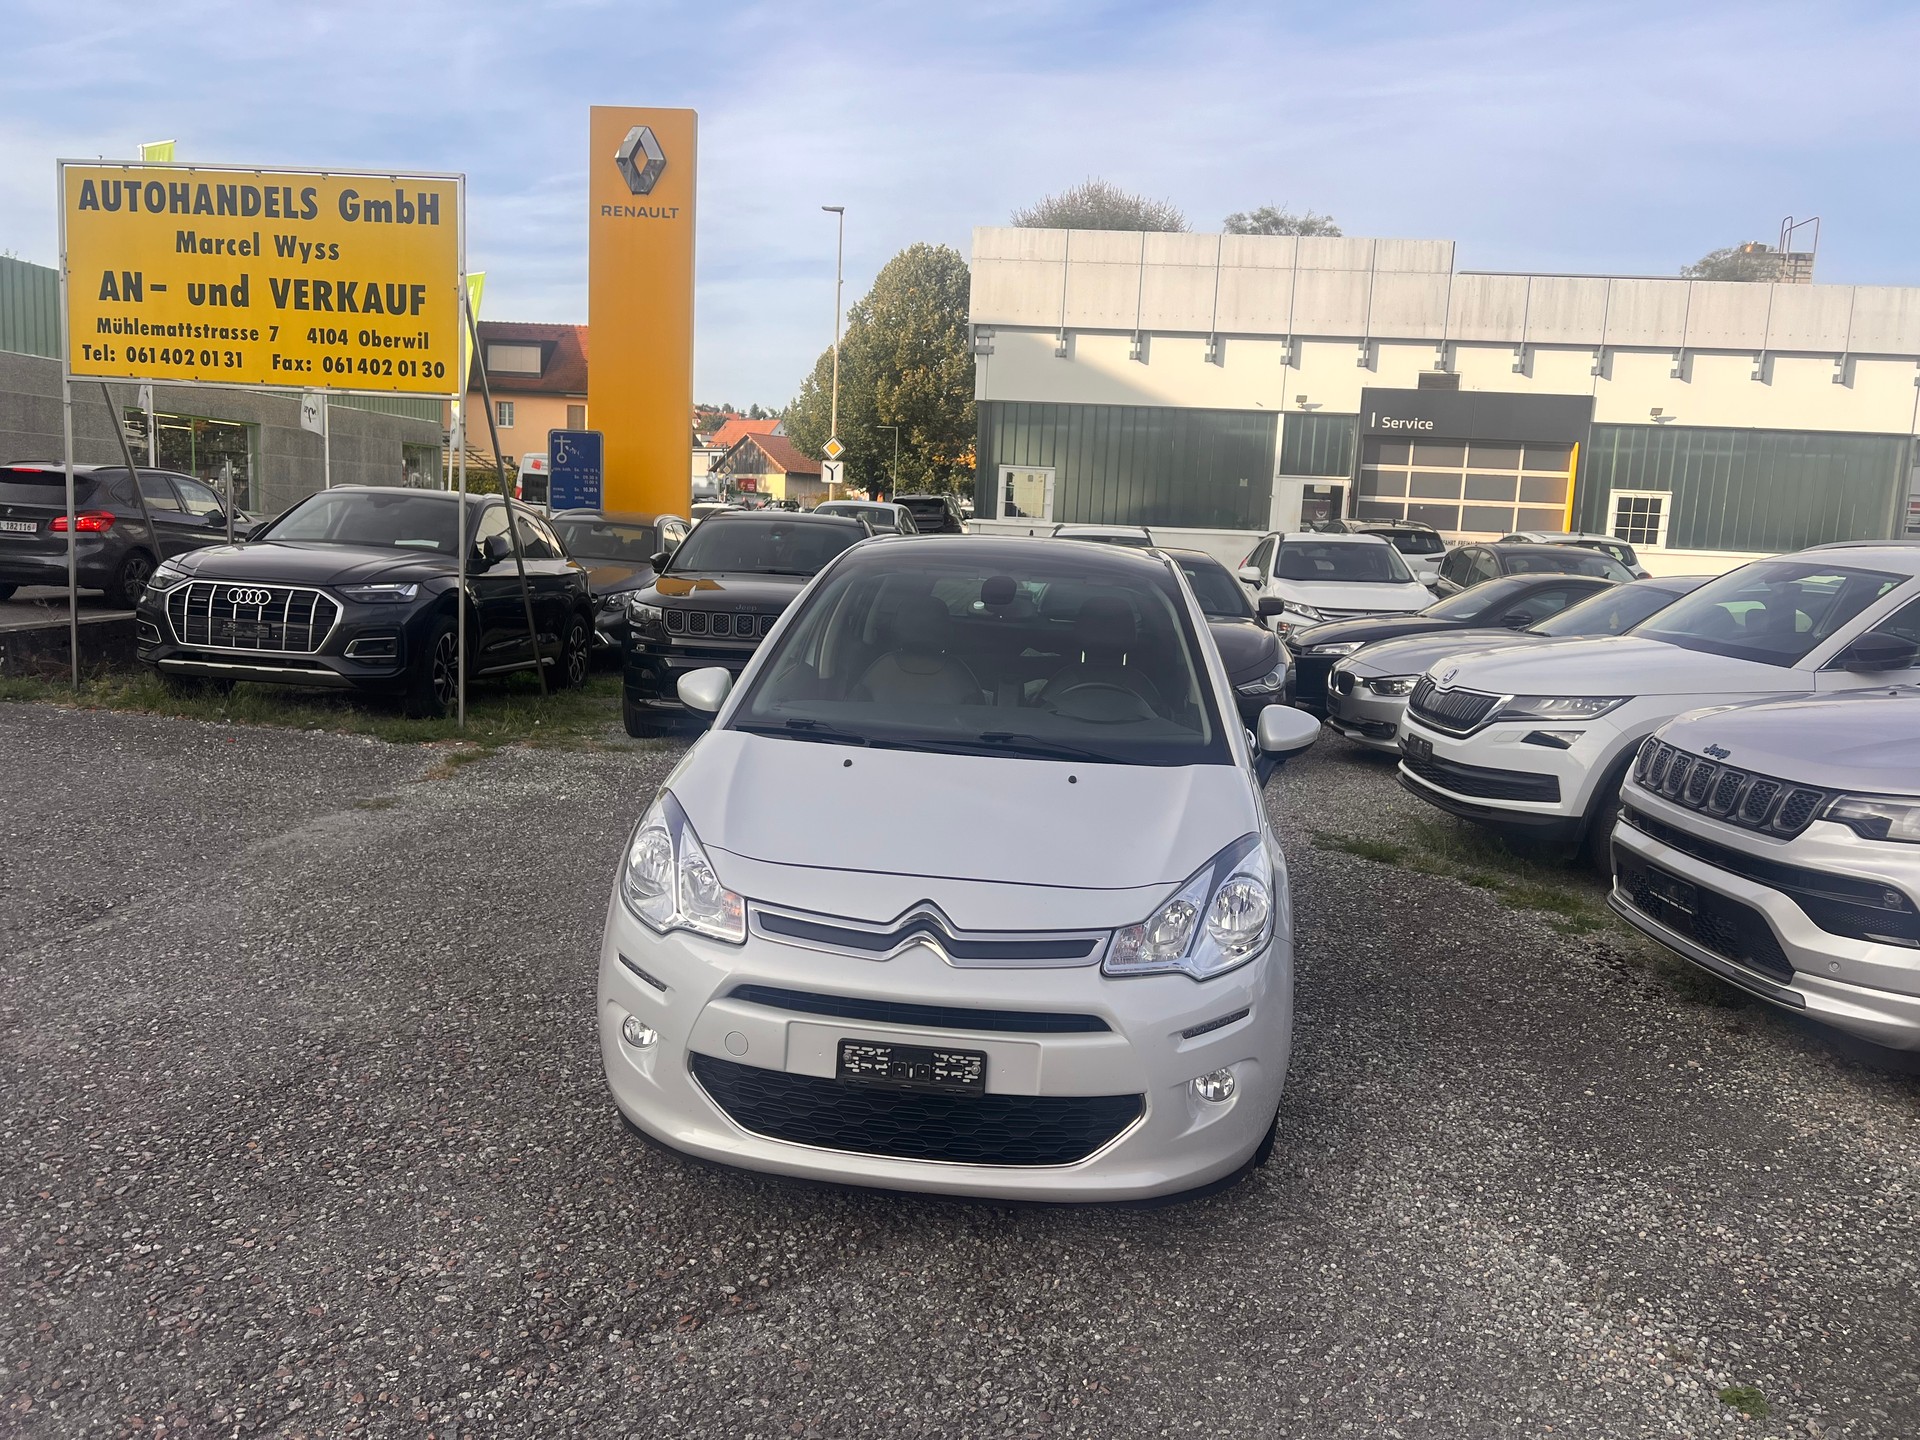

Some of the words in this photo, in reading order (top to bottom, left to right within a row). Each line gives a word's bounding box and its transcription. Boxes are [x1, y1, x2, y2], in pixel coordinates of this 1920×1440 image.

[78, 179, 318, 220] AUTOHANDELS
[338, 188, 439, 225] GmbH
[601, 205, 679, 219] RENAULT
[175, 230, 260, 257] Marcel
[273, 234, 340, 264] Wyss
[187, 273, 249, 308] und
[269, 277, 426, 316] VERKAUF
[96, 317, 260, 341] Mühlemattstrasse
[269, 325, 280, 342] 7
[306, 327, 349, 346] 4104
[358, 330, 429, 350] Oberwil
[82, 344, 116, 362] Tel:
[272, 353, 312, 372] Fax:
[1381, 416, 1434, 430] Service
